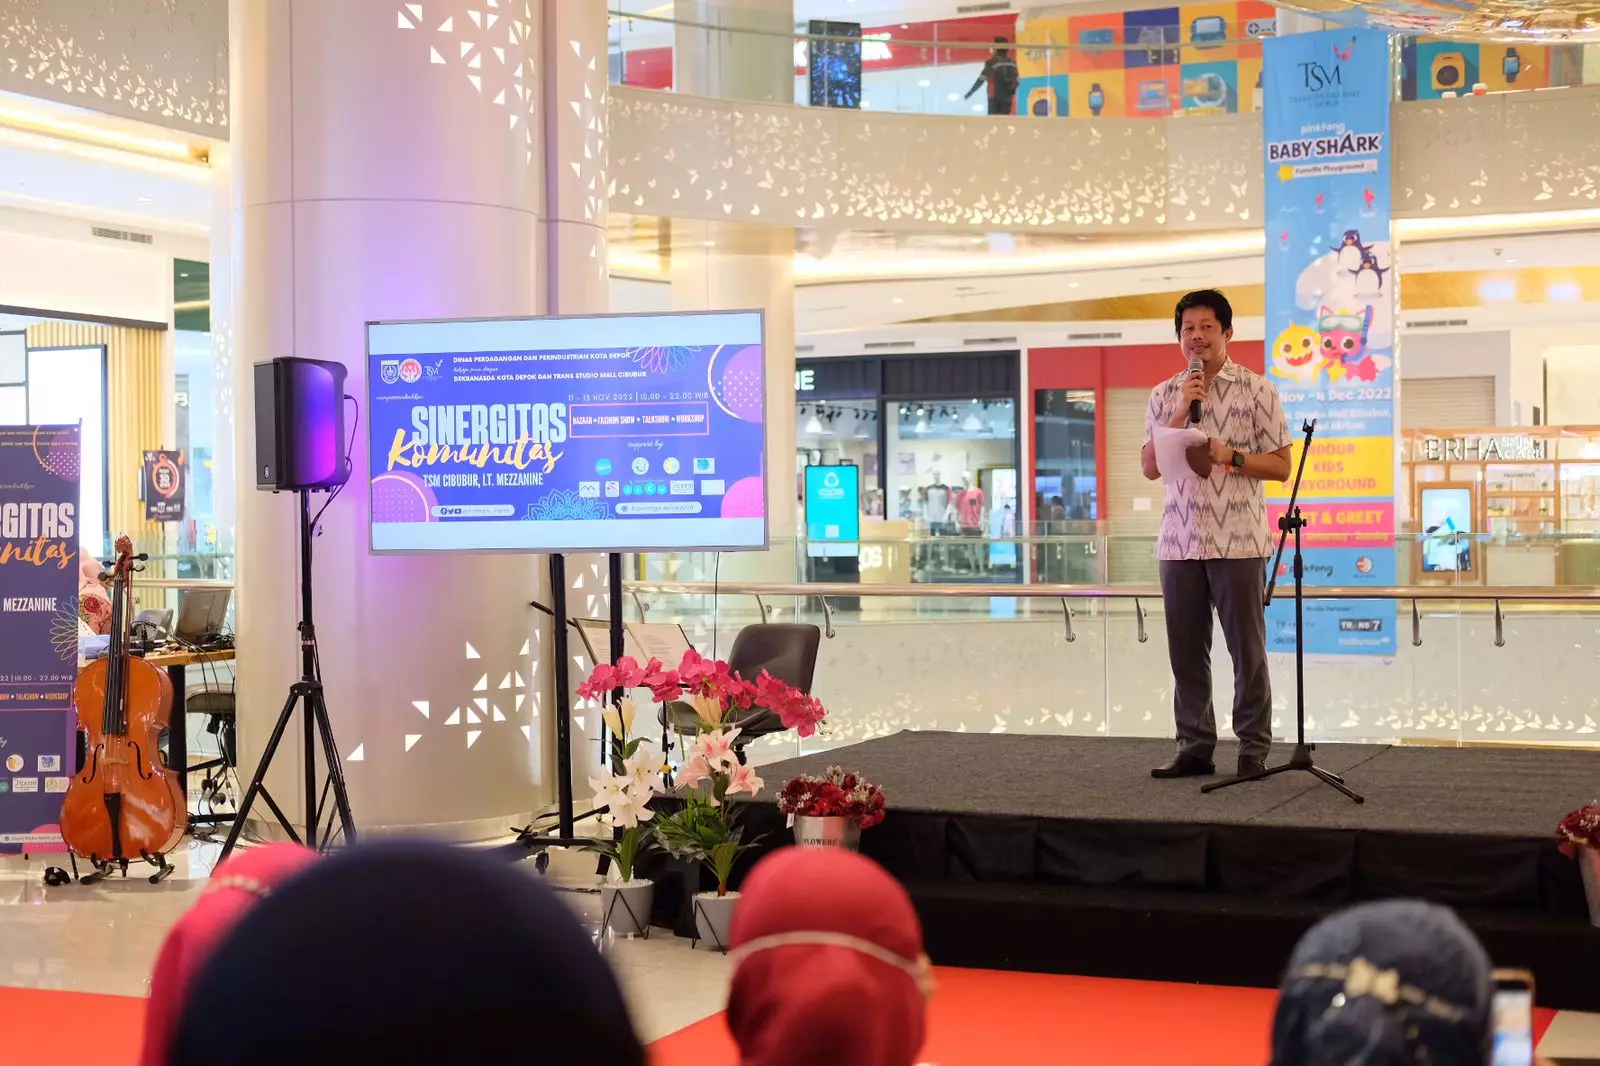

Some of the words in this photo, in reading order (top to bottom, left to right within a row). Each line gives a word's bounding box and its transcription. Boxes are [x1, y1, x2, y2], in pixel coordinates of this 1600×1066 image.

[1297, 62, 1342, 92] TSM
[1269, 141, 1312, 160] BABY
[1316, 134, 1380, 155] SHARK
[474, 355, 522, 363] PERDAGANGAN
[453, 374, 496, 382] DEKRANASDA
[538, 373, 552, 381] DAN
[1329, 389, 1354, 402] Dec
[1358, 388, 1391, 400] 2022
[411, 402, 567, 446] SINERGITAS
[573, 417, 593, 425] BAZAAR
[642, 415, 670, 424] TALKSHOW
[387, 428, 564, 474] Komunitas
[1307, 444, 1355, 456] NDOOR
[1425, 438, 1502, 460] ERHA
[1313, 462, 1344, 473] KIDS
[423, 474, 441, 487] TSM
[496, 472, 544, 486] MEZZANINE
[0, 503, 75, 538] GITAS
[1335, 510, 1384, 524] GREET
[1288, 565, 1333, 577] pkfong
[3, 597, 57, 612] MEZZANINE
